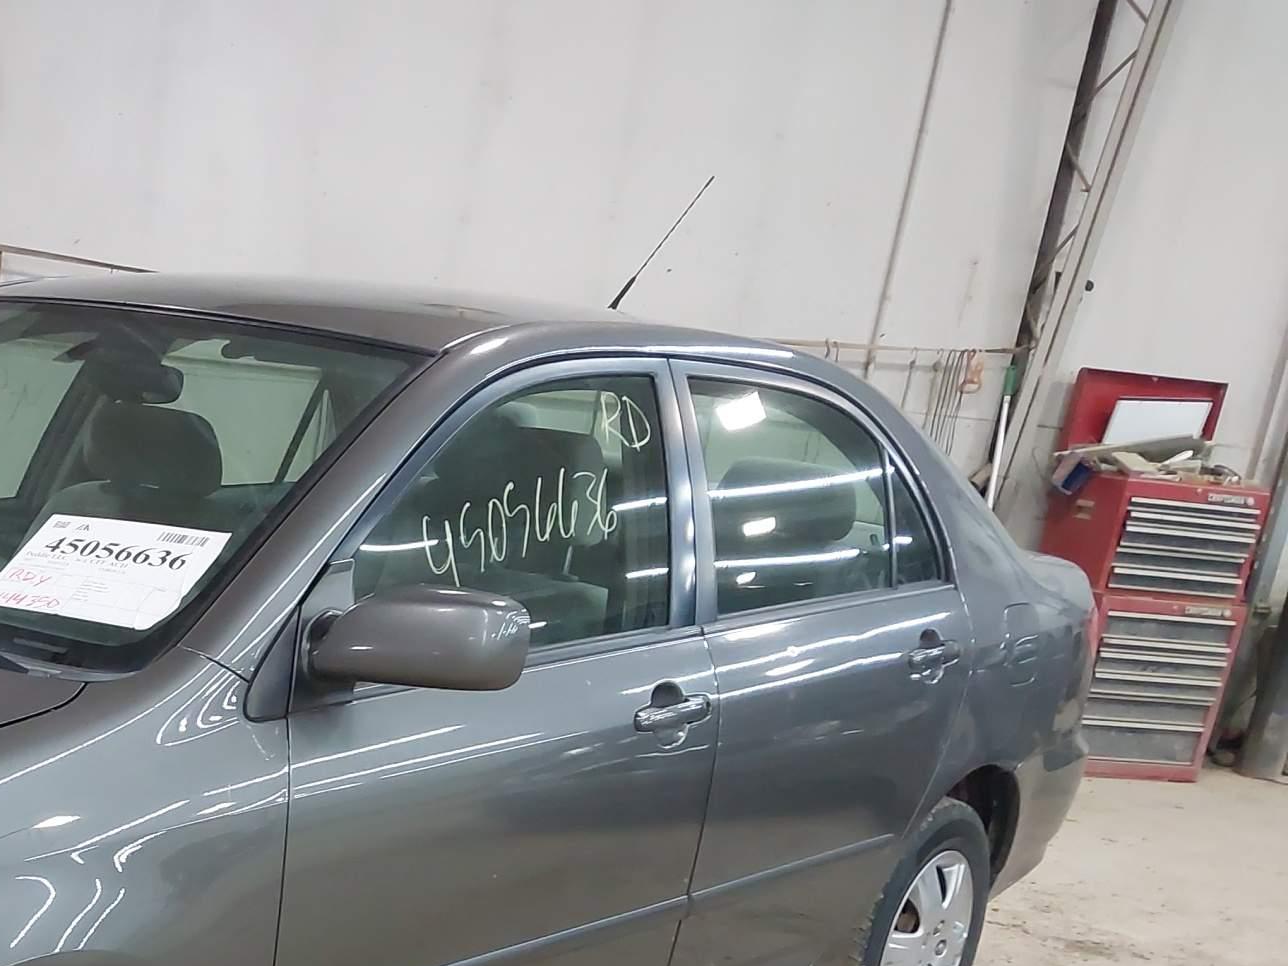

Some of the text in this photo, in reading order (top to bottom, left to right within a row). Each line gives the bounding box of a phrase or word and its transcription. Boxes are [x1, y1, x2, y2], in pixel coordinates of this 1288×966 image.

[600, 390, 651, 452] RD
[44, 536, 191, 571] 45056636
[421, 467, 618, 588] 45056636
